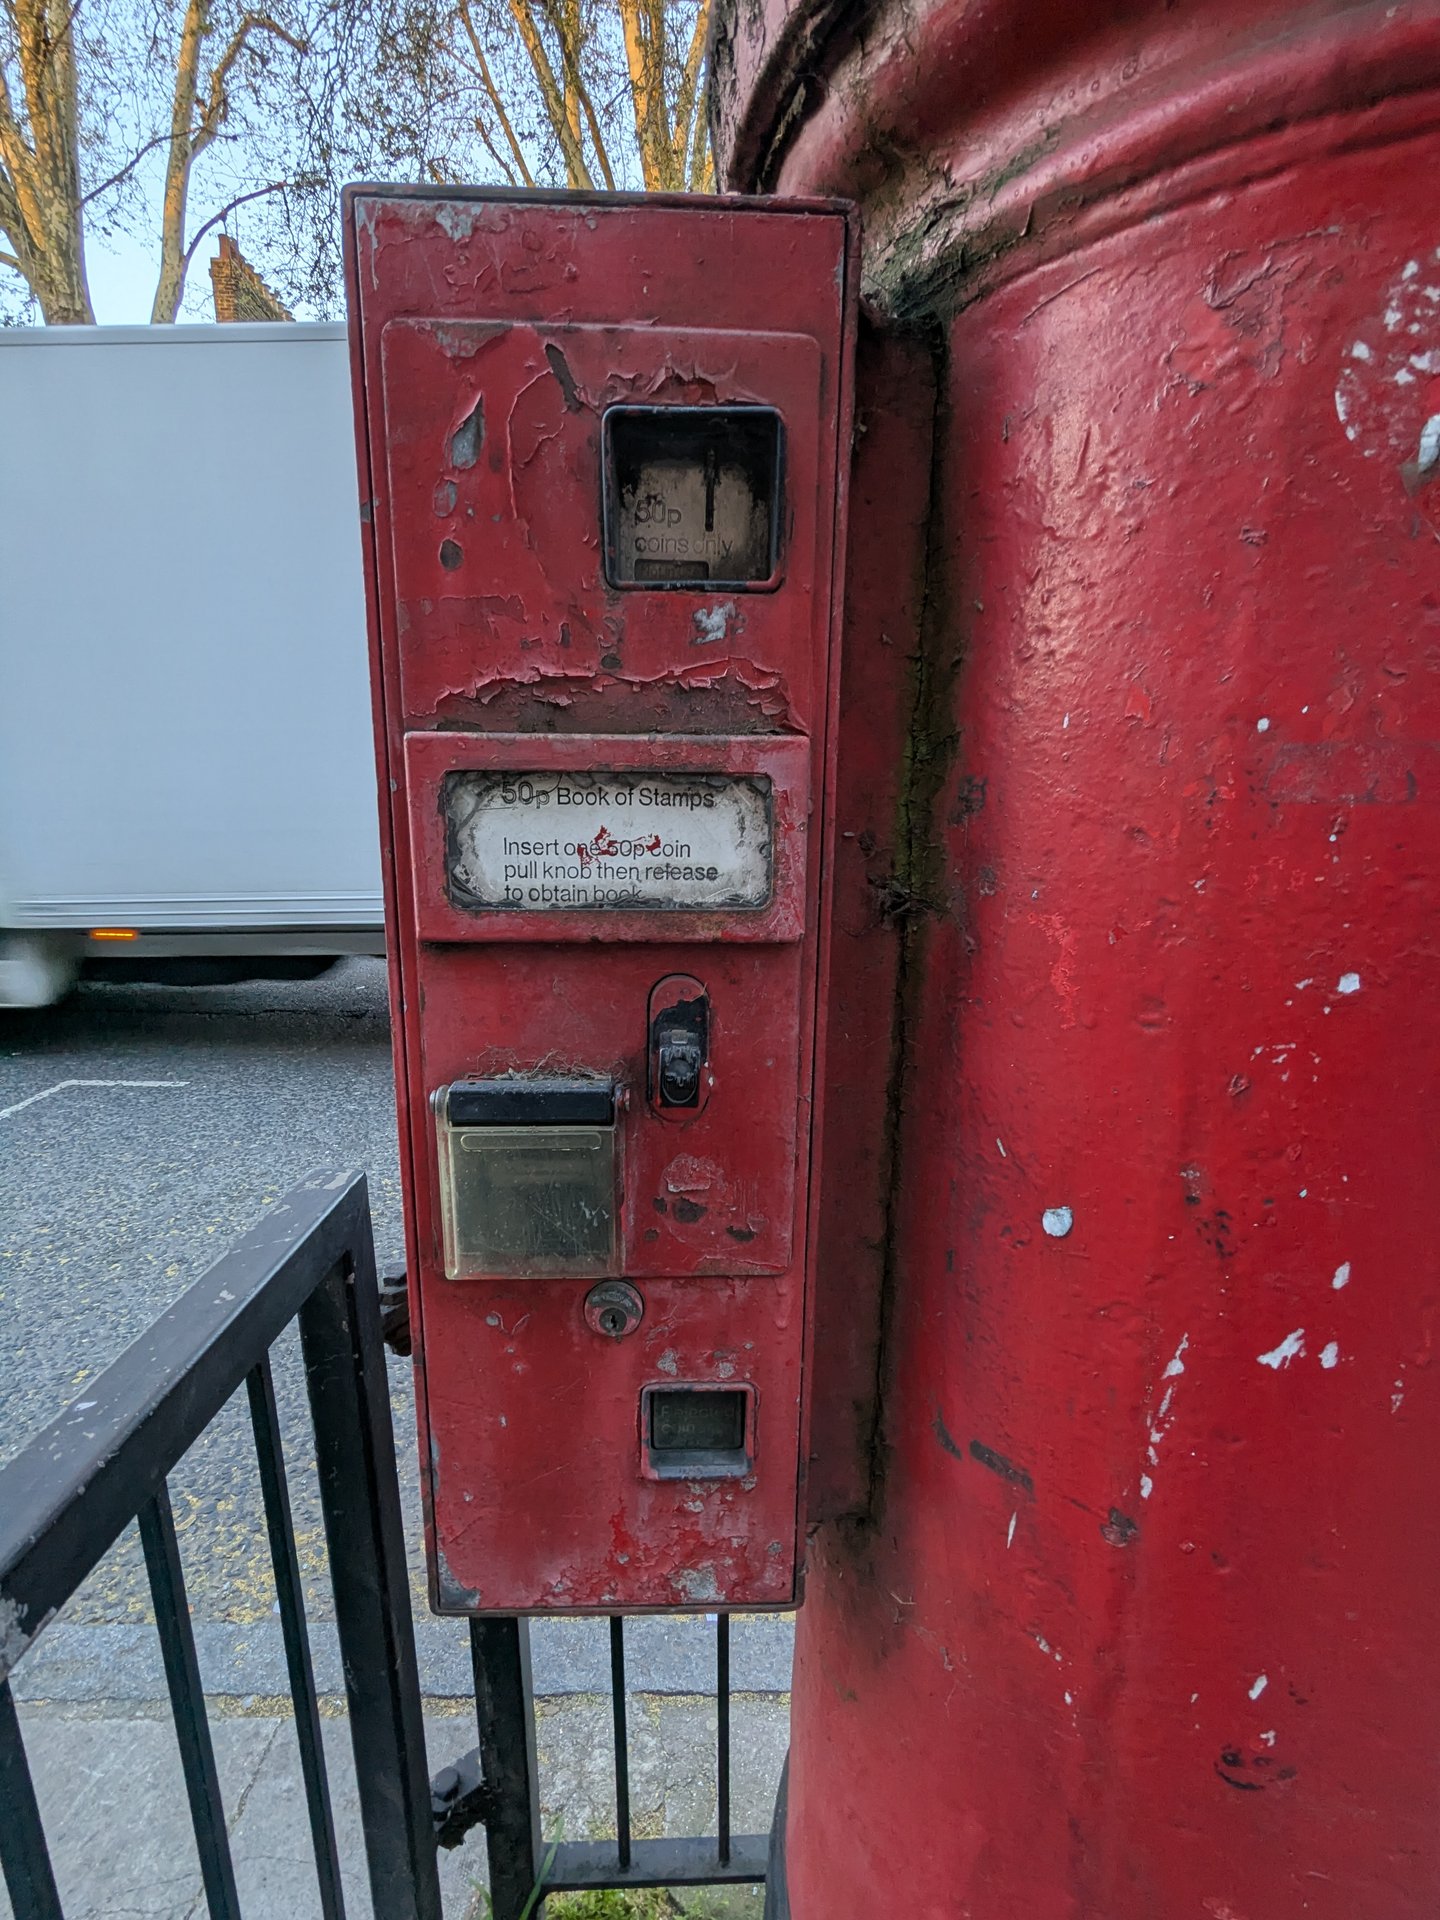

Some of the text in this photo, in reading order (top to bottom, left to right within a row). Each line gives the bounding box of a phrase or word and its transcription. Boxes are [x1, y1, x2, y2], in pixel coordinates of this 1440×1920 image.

[635, 500, 682, 528] 50p
[635, 534, 733, 558] coins only
[501, 781, 715, 811] 50p Book of Stamps
[504, 837, 691, 860] Insert one 50p coin
[504, 861, 719, 881] pull knob then release
[504, 884, 642, 902] to obtain book
